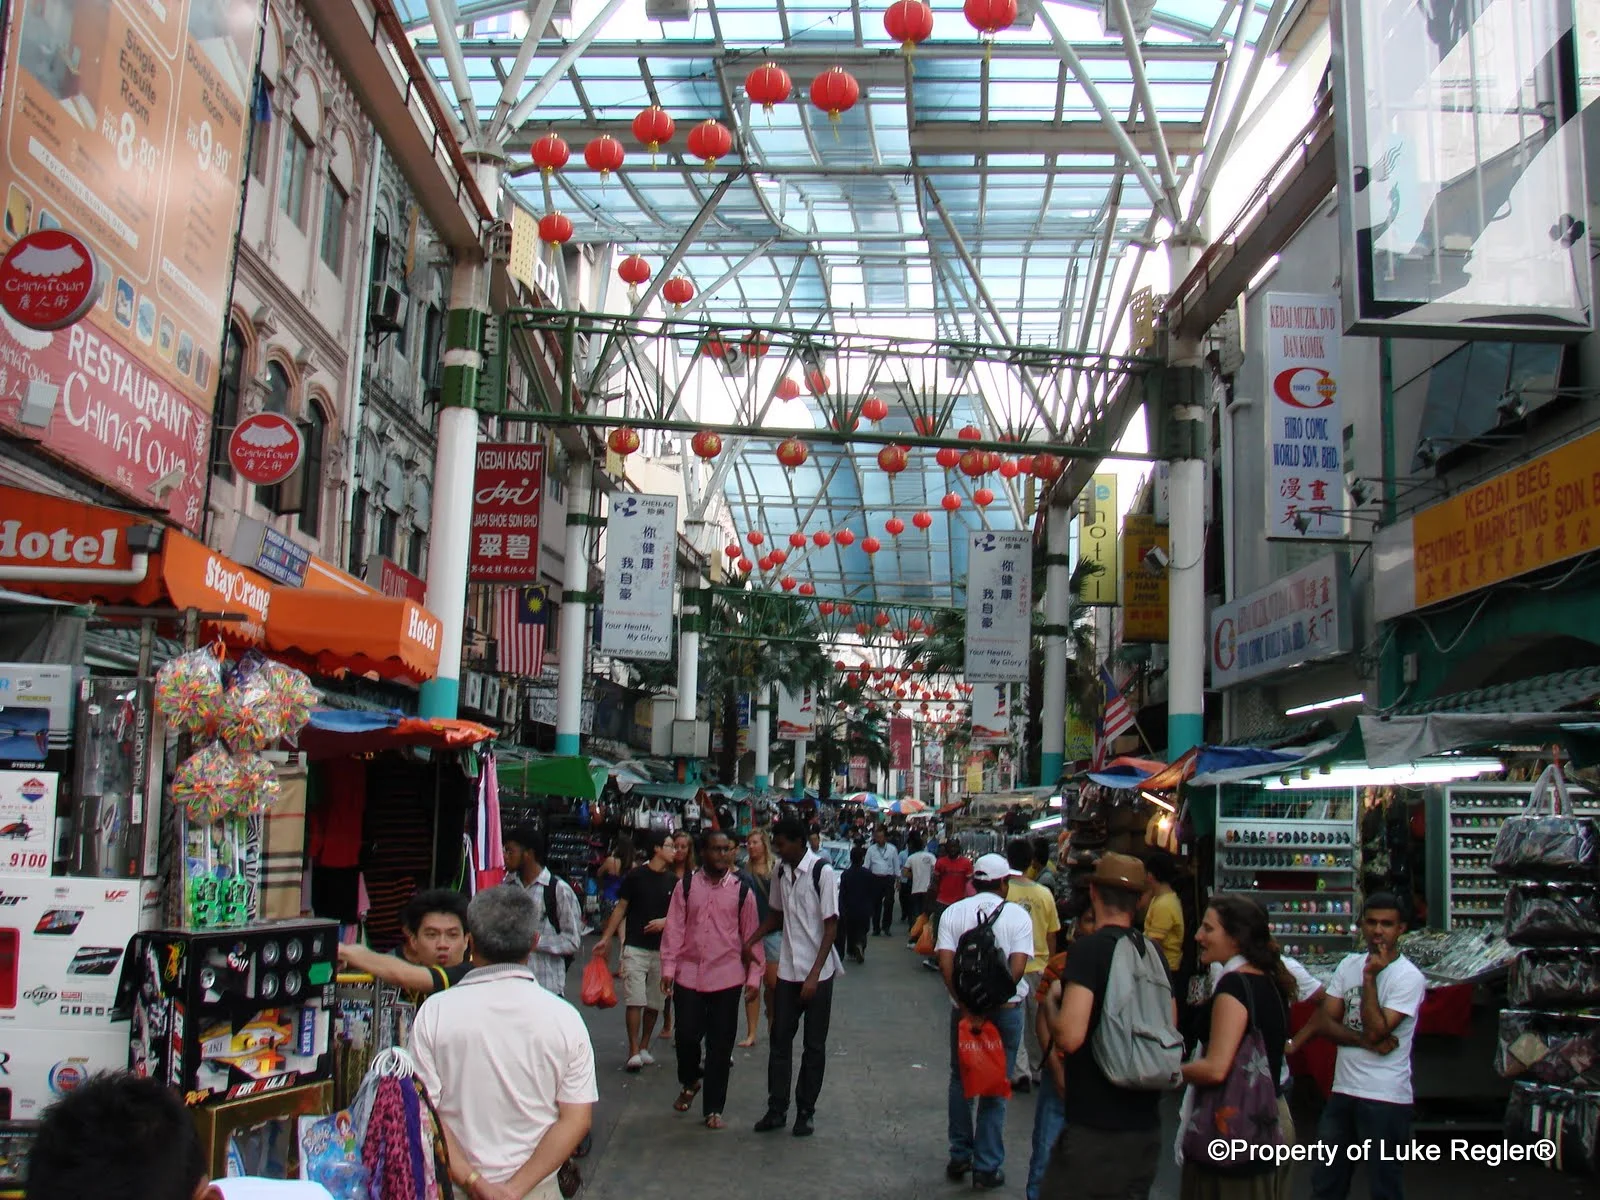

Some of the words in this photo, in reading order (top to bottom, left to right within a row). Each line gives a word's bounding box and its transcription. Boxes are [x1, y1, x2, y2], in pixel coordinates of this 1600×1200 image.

[126, 28, 157, 80] Single
[186, 45, 216, 89] Double
[119, 48, 157, 106] Ensuite
[120, 78, 150, 127] Room
[201, 89, 225, 128] Room
[1270, 305, 1292, 328] KEDAI
[1320, 306, 1336, 330] DVD
[1283, 335, 1299, 357] DAN
[1299, 335, 1325, 359] KOMIK
[68, 323, 193, 442] RESTAURANT
[1284, 416, 1302, 440] HIRO
[1305, 417, 1328, 441] COMIC
[477, 451, 506, 471] KEDAI
[507, 451, 542, 471] KASUT
[1273, 443, 1300, 467] WORLD
[1464, 477, 1509, 522] KEDAI
[1515, 460, 1550, 500] BEG
[473, 514, 489, 528] JAPI
[488, 514, 508, 528] SHOE
[508, 514, 523, 528] SDN
[523, 514, 538, 528] BHD
[1473, 494, 1549, 549] MARKETING
[641, 526, 656, 570] 你健康
[619, 556, 634, 600] 我自豪
[407, 607, 437, 651] Hotel
[605, 622, 622, 630] Your
[627, 633, 640, 642] My
[641, 634, 666, 643] Glory
[132, 707, 146, 786] HELICOPTER
[9, 853, 48, 869] 9100
[23, 988, 58, 1001] GYRO
